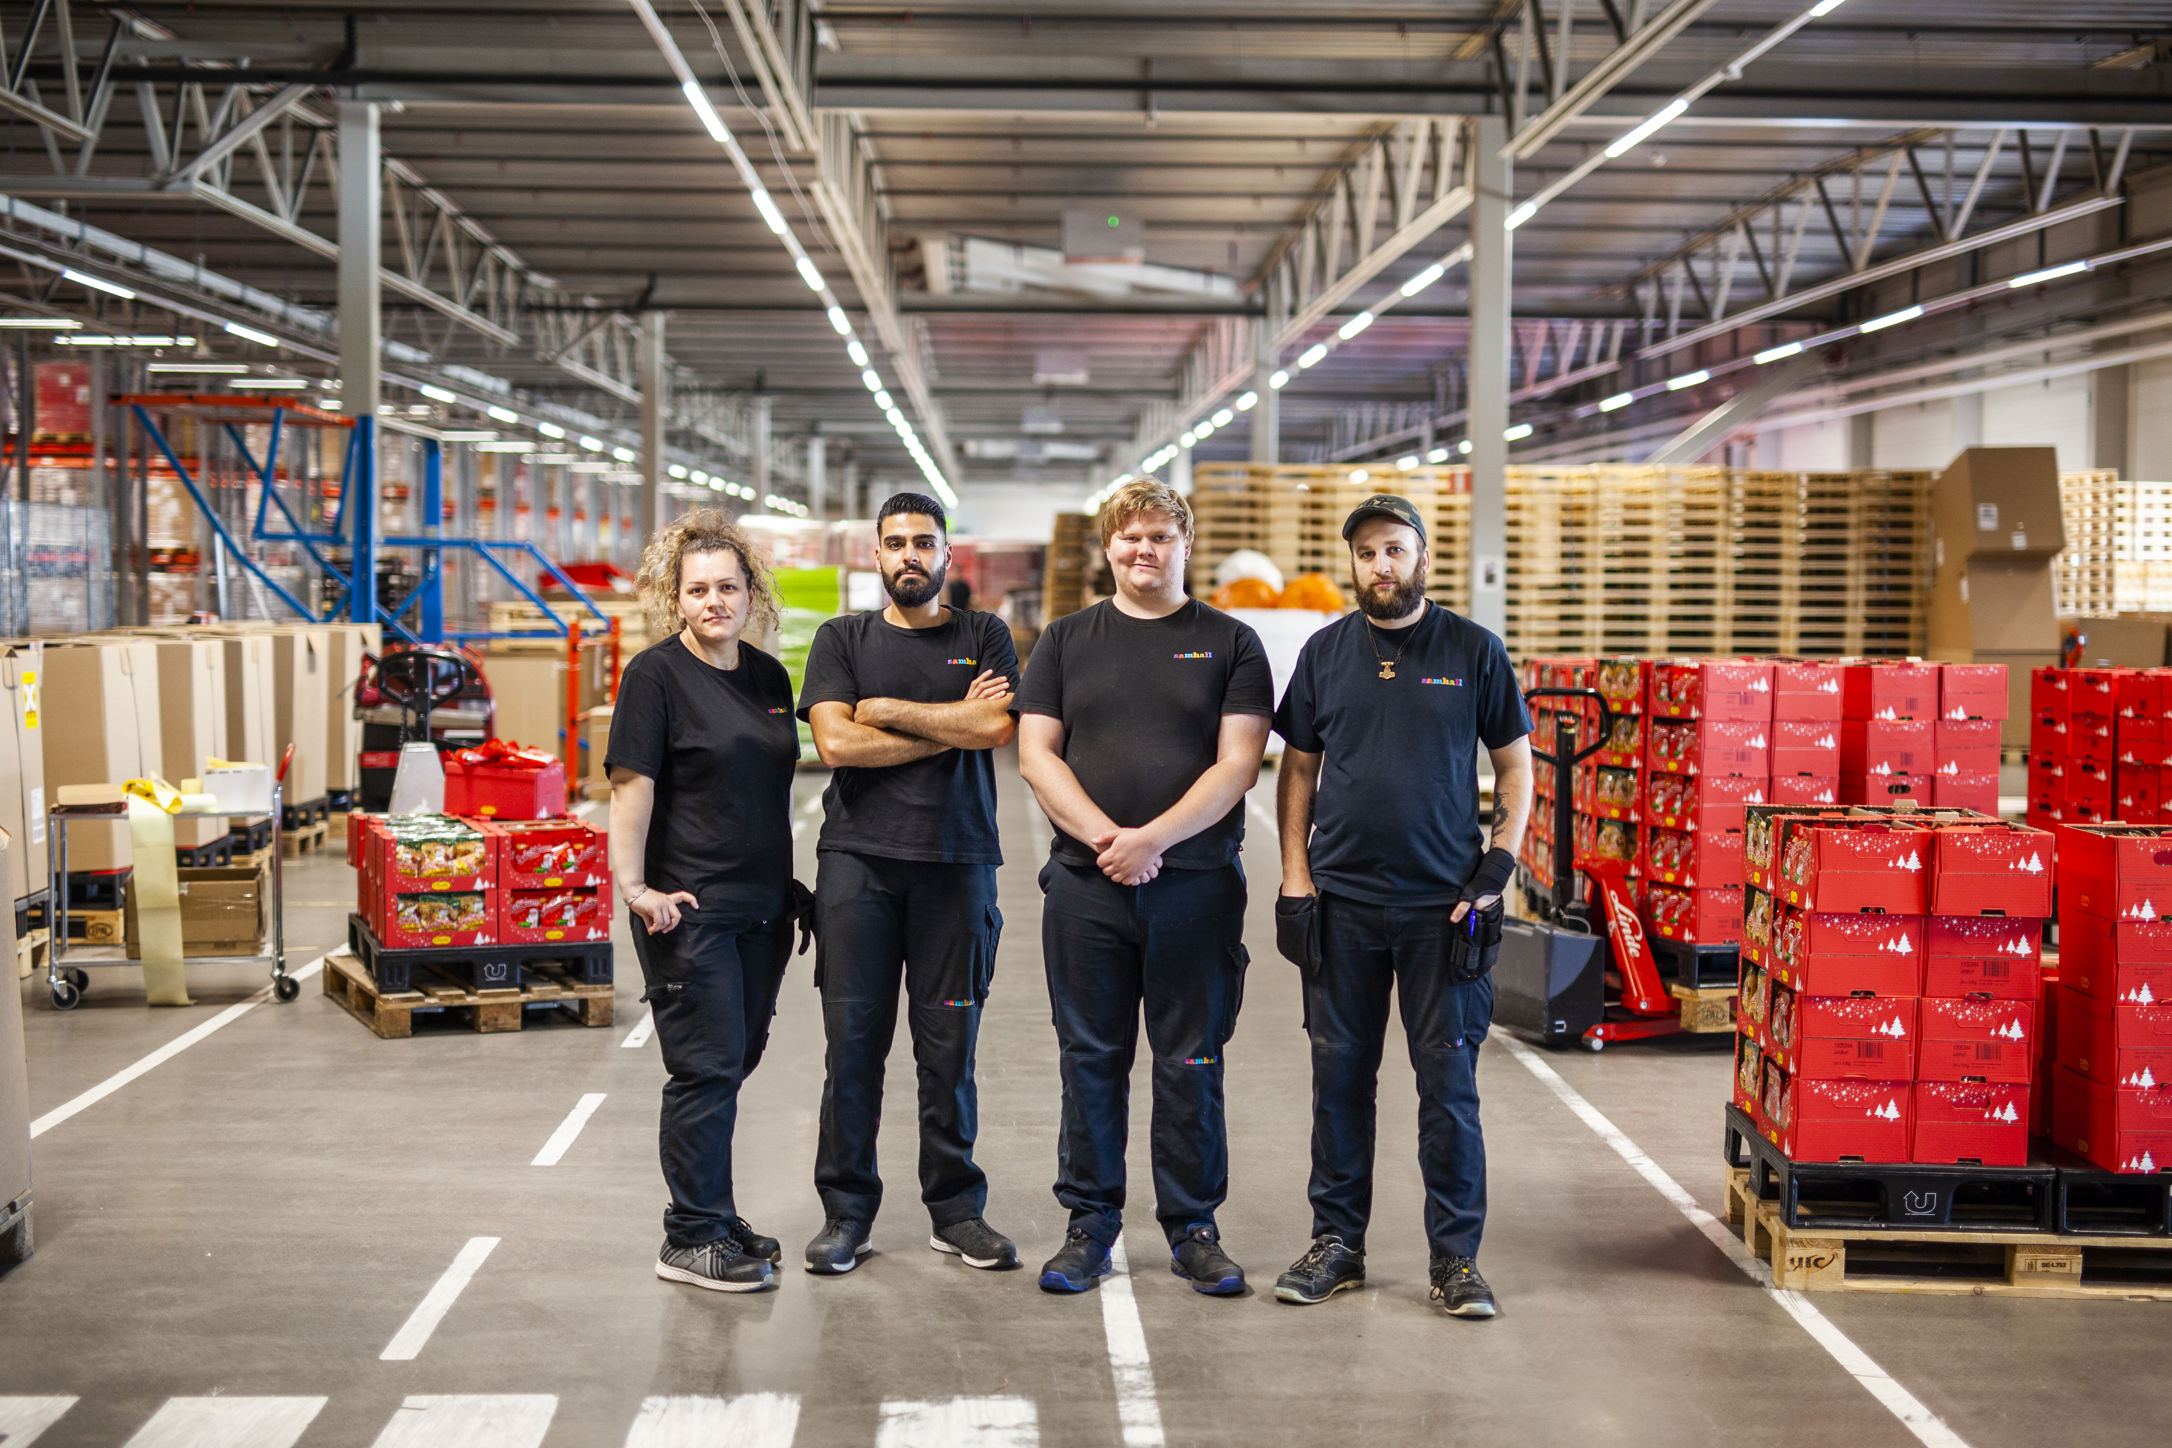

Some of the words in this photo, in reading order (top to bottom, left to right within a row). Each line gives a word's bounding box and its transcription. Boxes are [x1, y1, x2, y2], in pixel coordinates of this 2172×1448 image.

[1173, 651, 1212, 659] samhall
[947, 657, 977, 665] samha
[1421, 676, 1463, 687] samhall
[1610, 889, 1643, 958] Linde
